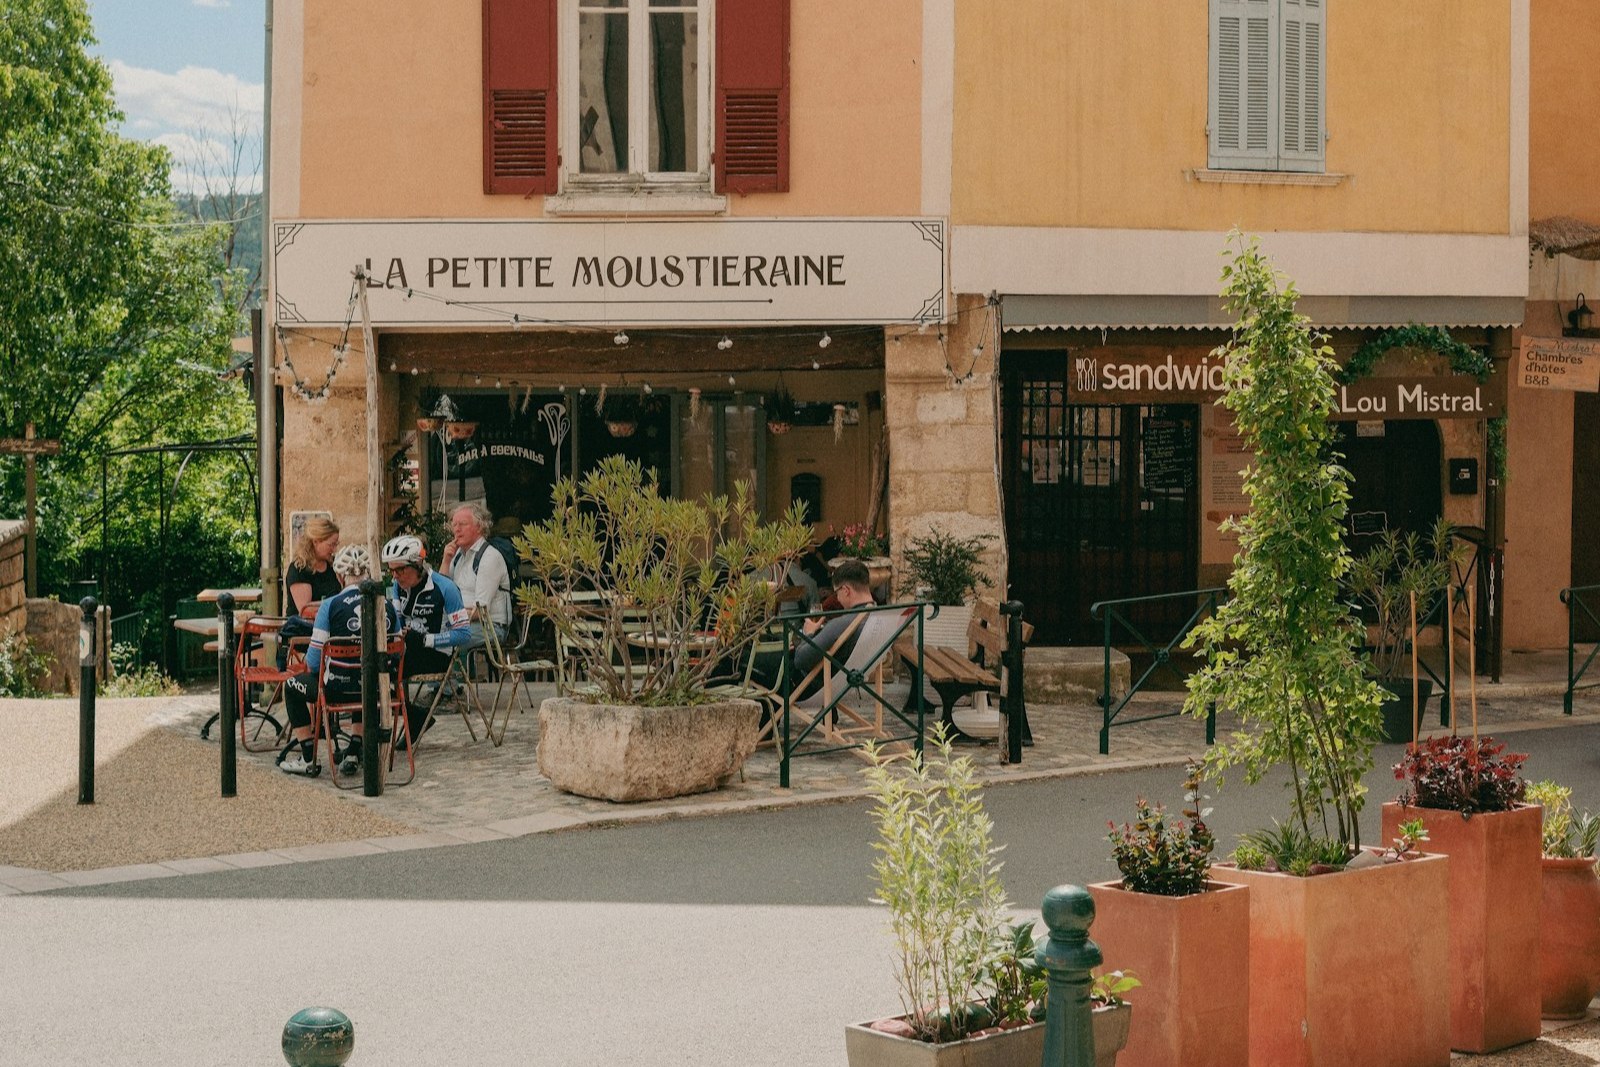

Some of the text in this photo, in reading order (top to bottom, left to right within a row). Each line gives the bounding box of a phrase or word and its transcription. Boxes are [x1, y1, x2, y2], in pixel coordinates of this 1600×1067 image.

[366, 254, 847, 289] LA PETITE MOUSTIERAINE
[1526, 351, 1583, 365] Chambres
[1525, 362, 1566, 374] d'hôtes
[1524, 374, 1550, 386] B&B
[1341, 383, 1483, 413] Lou Mistral
[458, 444, 545, 466] BAR À COCKTAILS
